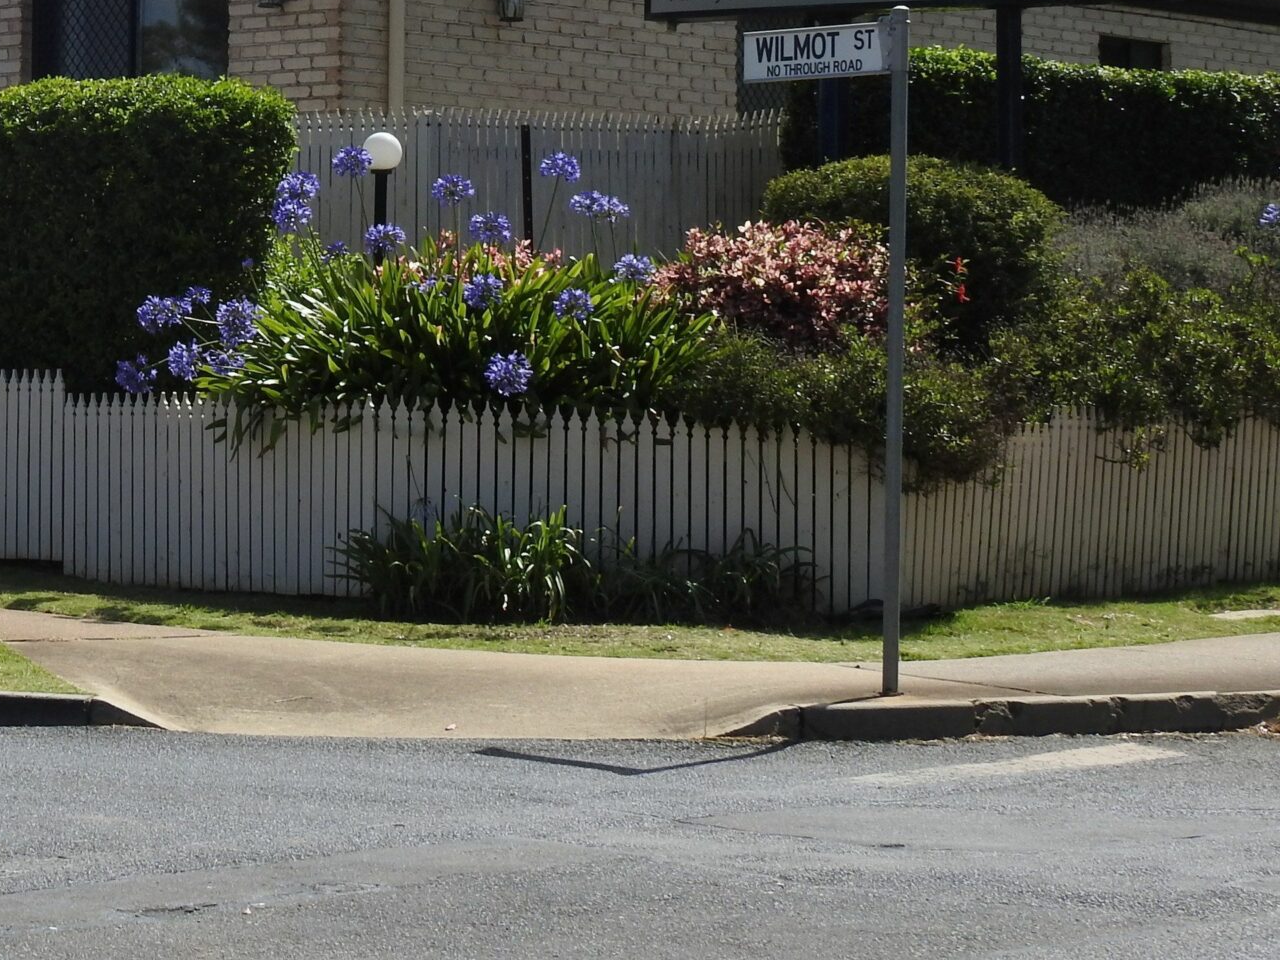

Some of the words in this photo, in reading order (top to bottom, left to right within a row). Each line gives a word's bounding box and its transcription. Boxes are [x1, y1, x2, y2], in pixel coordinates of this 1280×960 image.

[756, 31, 840, 63] WILMOT
[854, 29, 875, 50] ST
[767, 64, 780, 77] NO
[784, 61, 831, 76] THROUGH
[833, 59, 862, 72] ROAD
